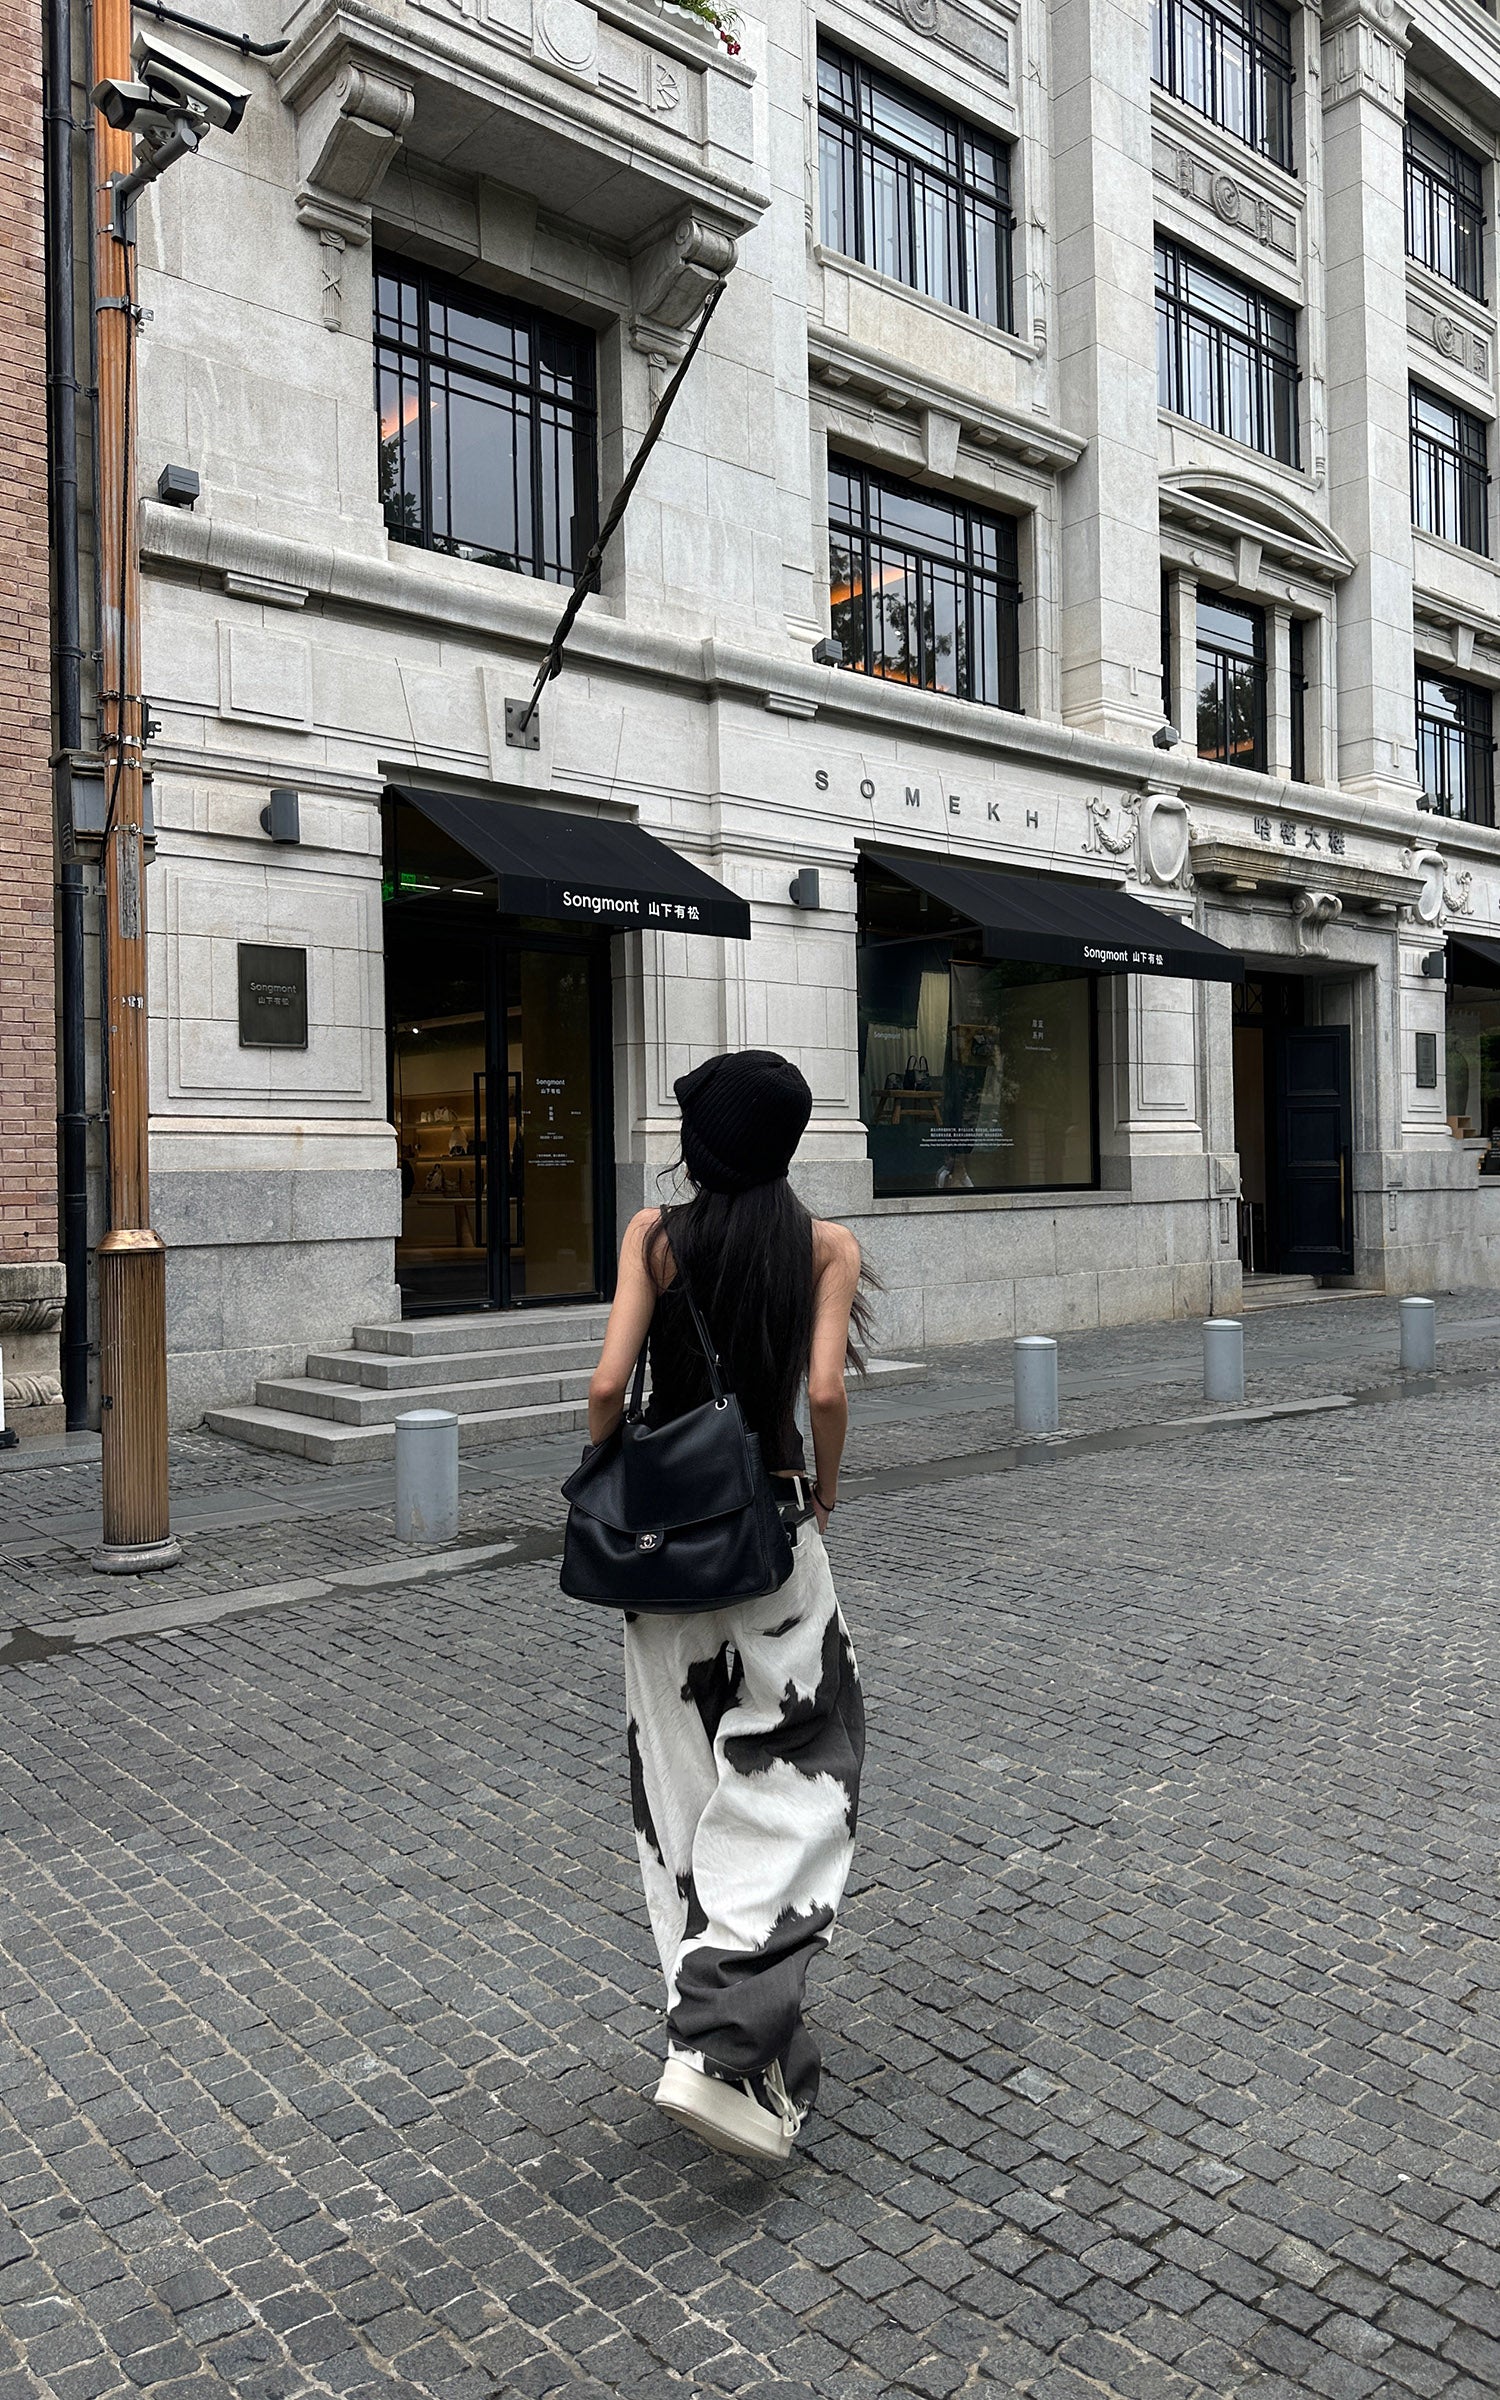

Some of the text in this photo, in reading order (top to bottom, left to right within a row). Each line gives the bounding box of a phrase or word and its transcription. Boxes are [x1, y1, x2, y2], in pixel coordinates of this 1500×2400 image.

[815, 769, 1039, 829] SOMEKH
[1254, 816, 1345, 855] 哈密大楼
[563, 891, 700, 920] Songmont 山下有松
[1083, 945, 1164, 966] Songmont 山下有松
[250, 982, 297, 994] Songmont
[536, 1078, 565, 1087] Songmont
